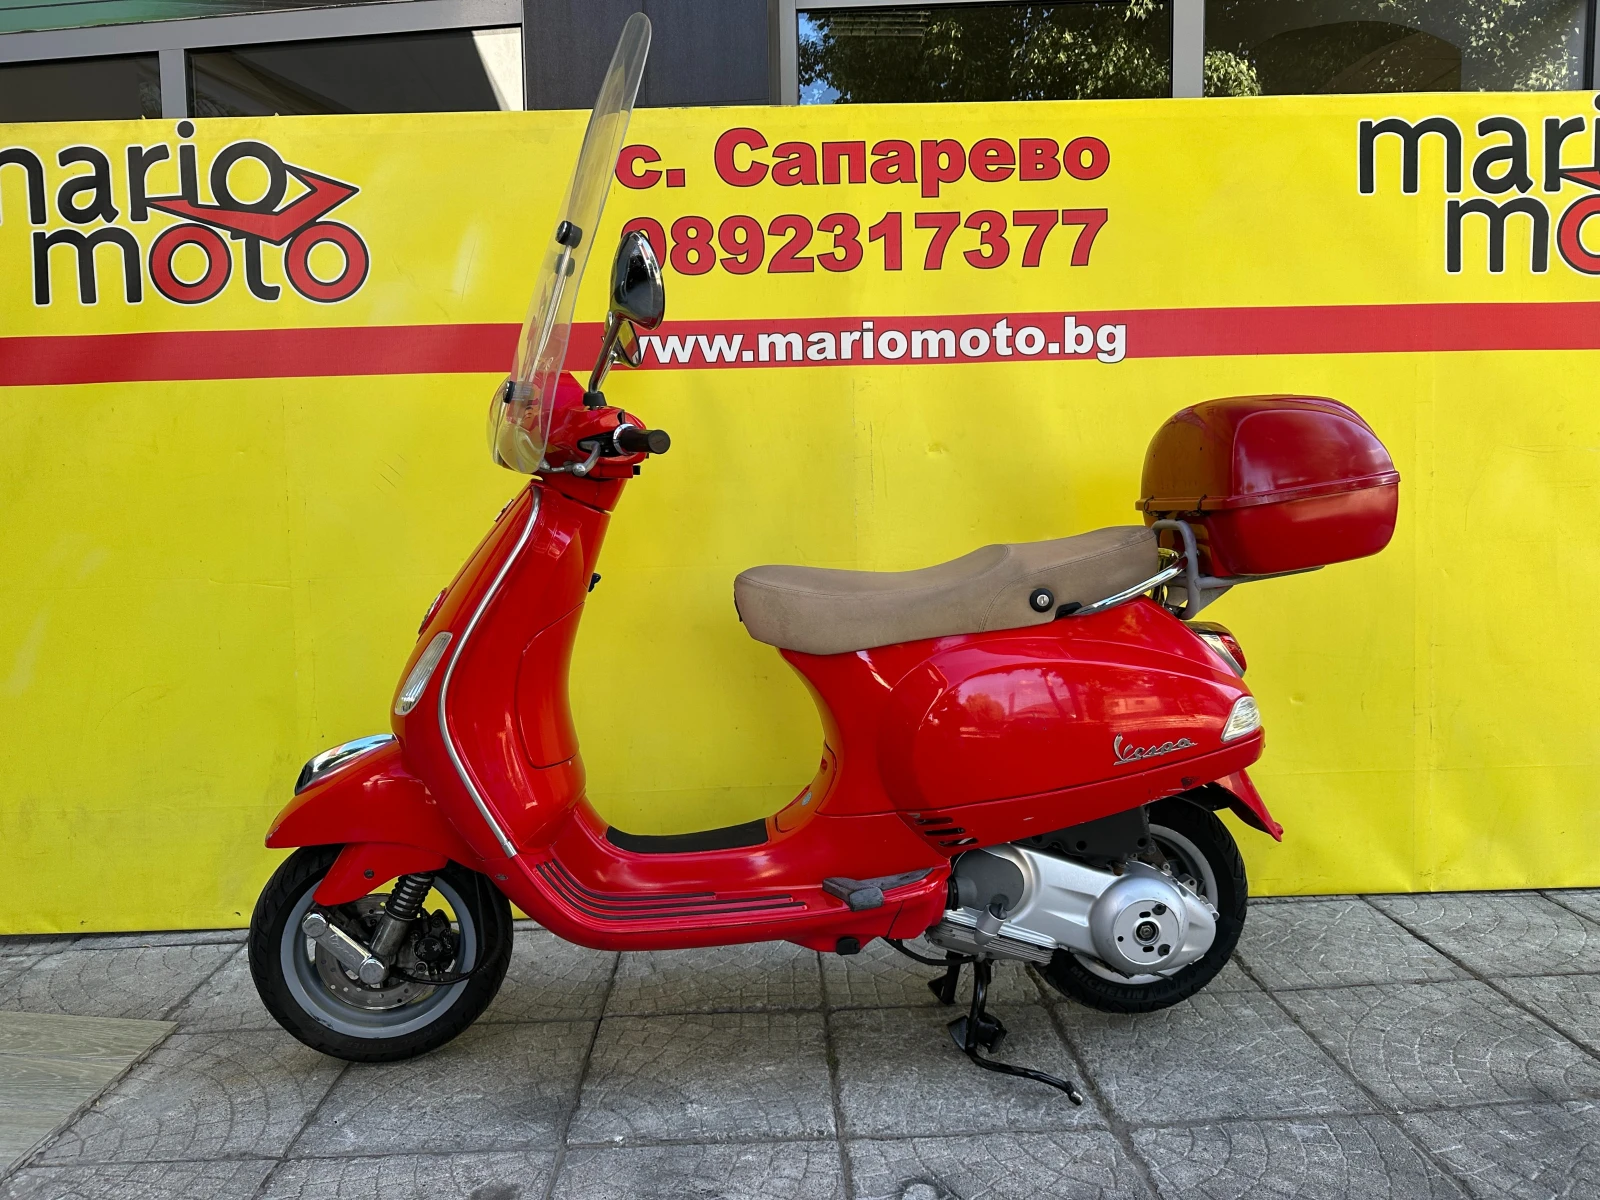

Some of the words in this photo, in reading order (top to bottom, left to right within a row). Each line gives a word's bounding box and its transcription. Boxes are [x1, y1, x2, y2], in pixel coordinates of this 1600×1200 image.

[615, 144, 686, 189] с.
[714, 127, 1111, 198] Сапарево
[33, 220, 370, 305] moto
[602, 316, 1128, 364] ww.mariomoto.bg
[1113, 732, 1198, 766] Vespa
[1070, 966, 1145, 999] MICHELIN
